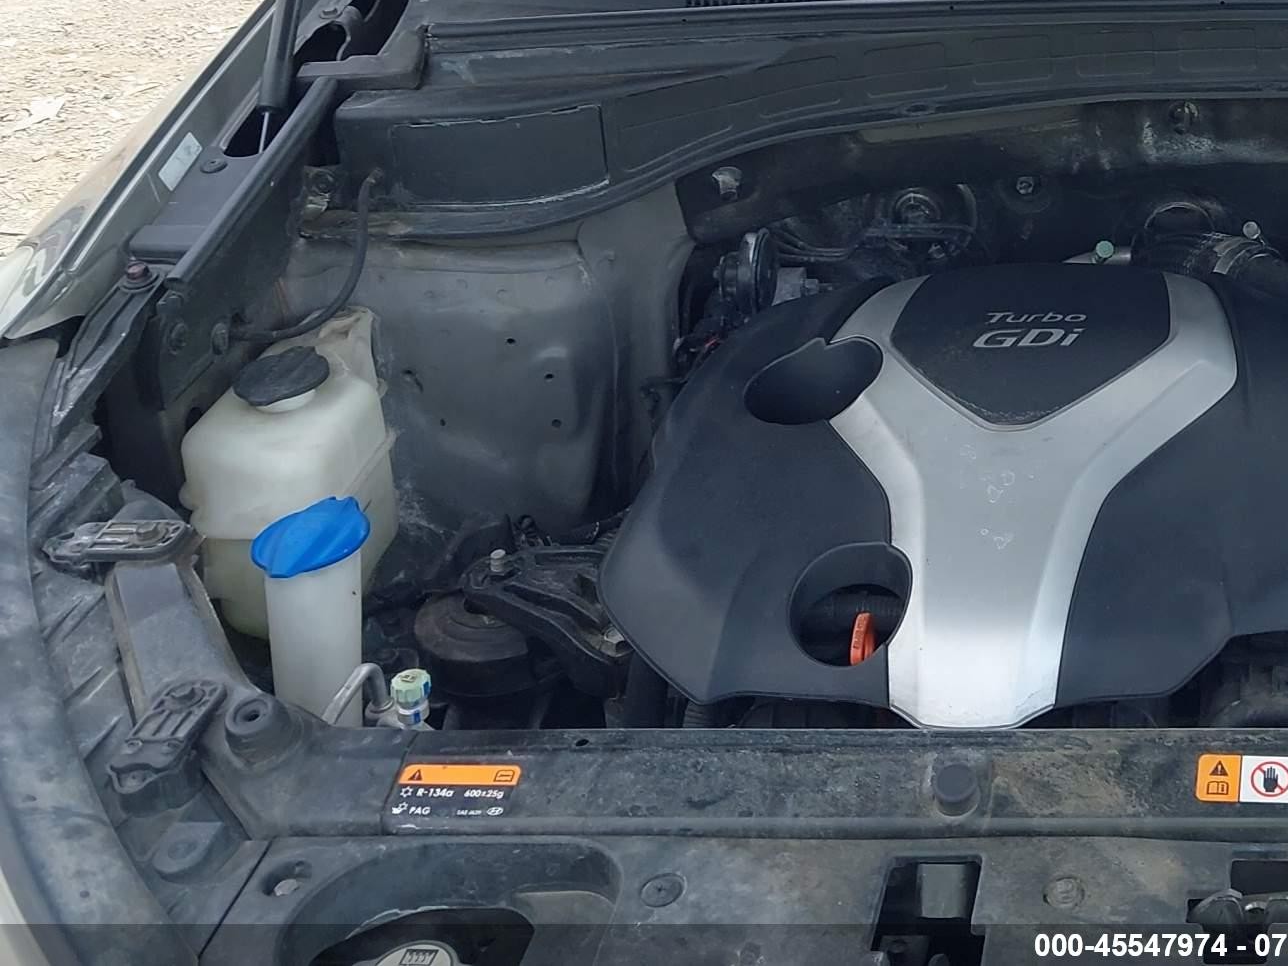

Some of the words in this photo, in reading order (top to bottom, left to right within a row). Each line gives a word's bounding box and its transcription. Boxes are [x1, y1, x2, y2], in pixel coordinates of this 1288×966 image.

[986, 312, 1088, 323] Turbo
[973, 328, 1086, 348] GDi
[416, 787, 455, 798] R-134a
[463, 789, 505, 800] 600±25g
[408, 806, 431, 816] PAG
